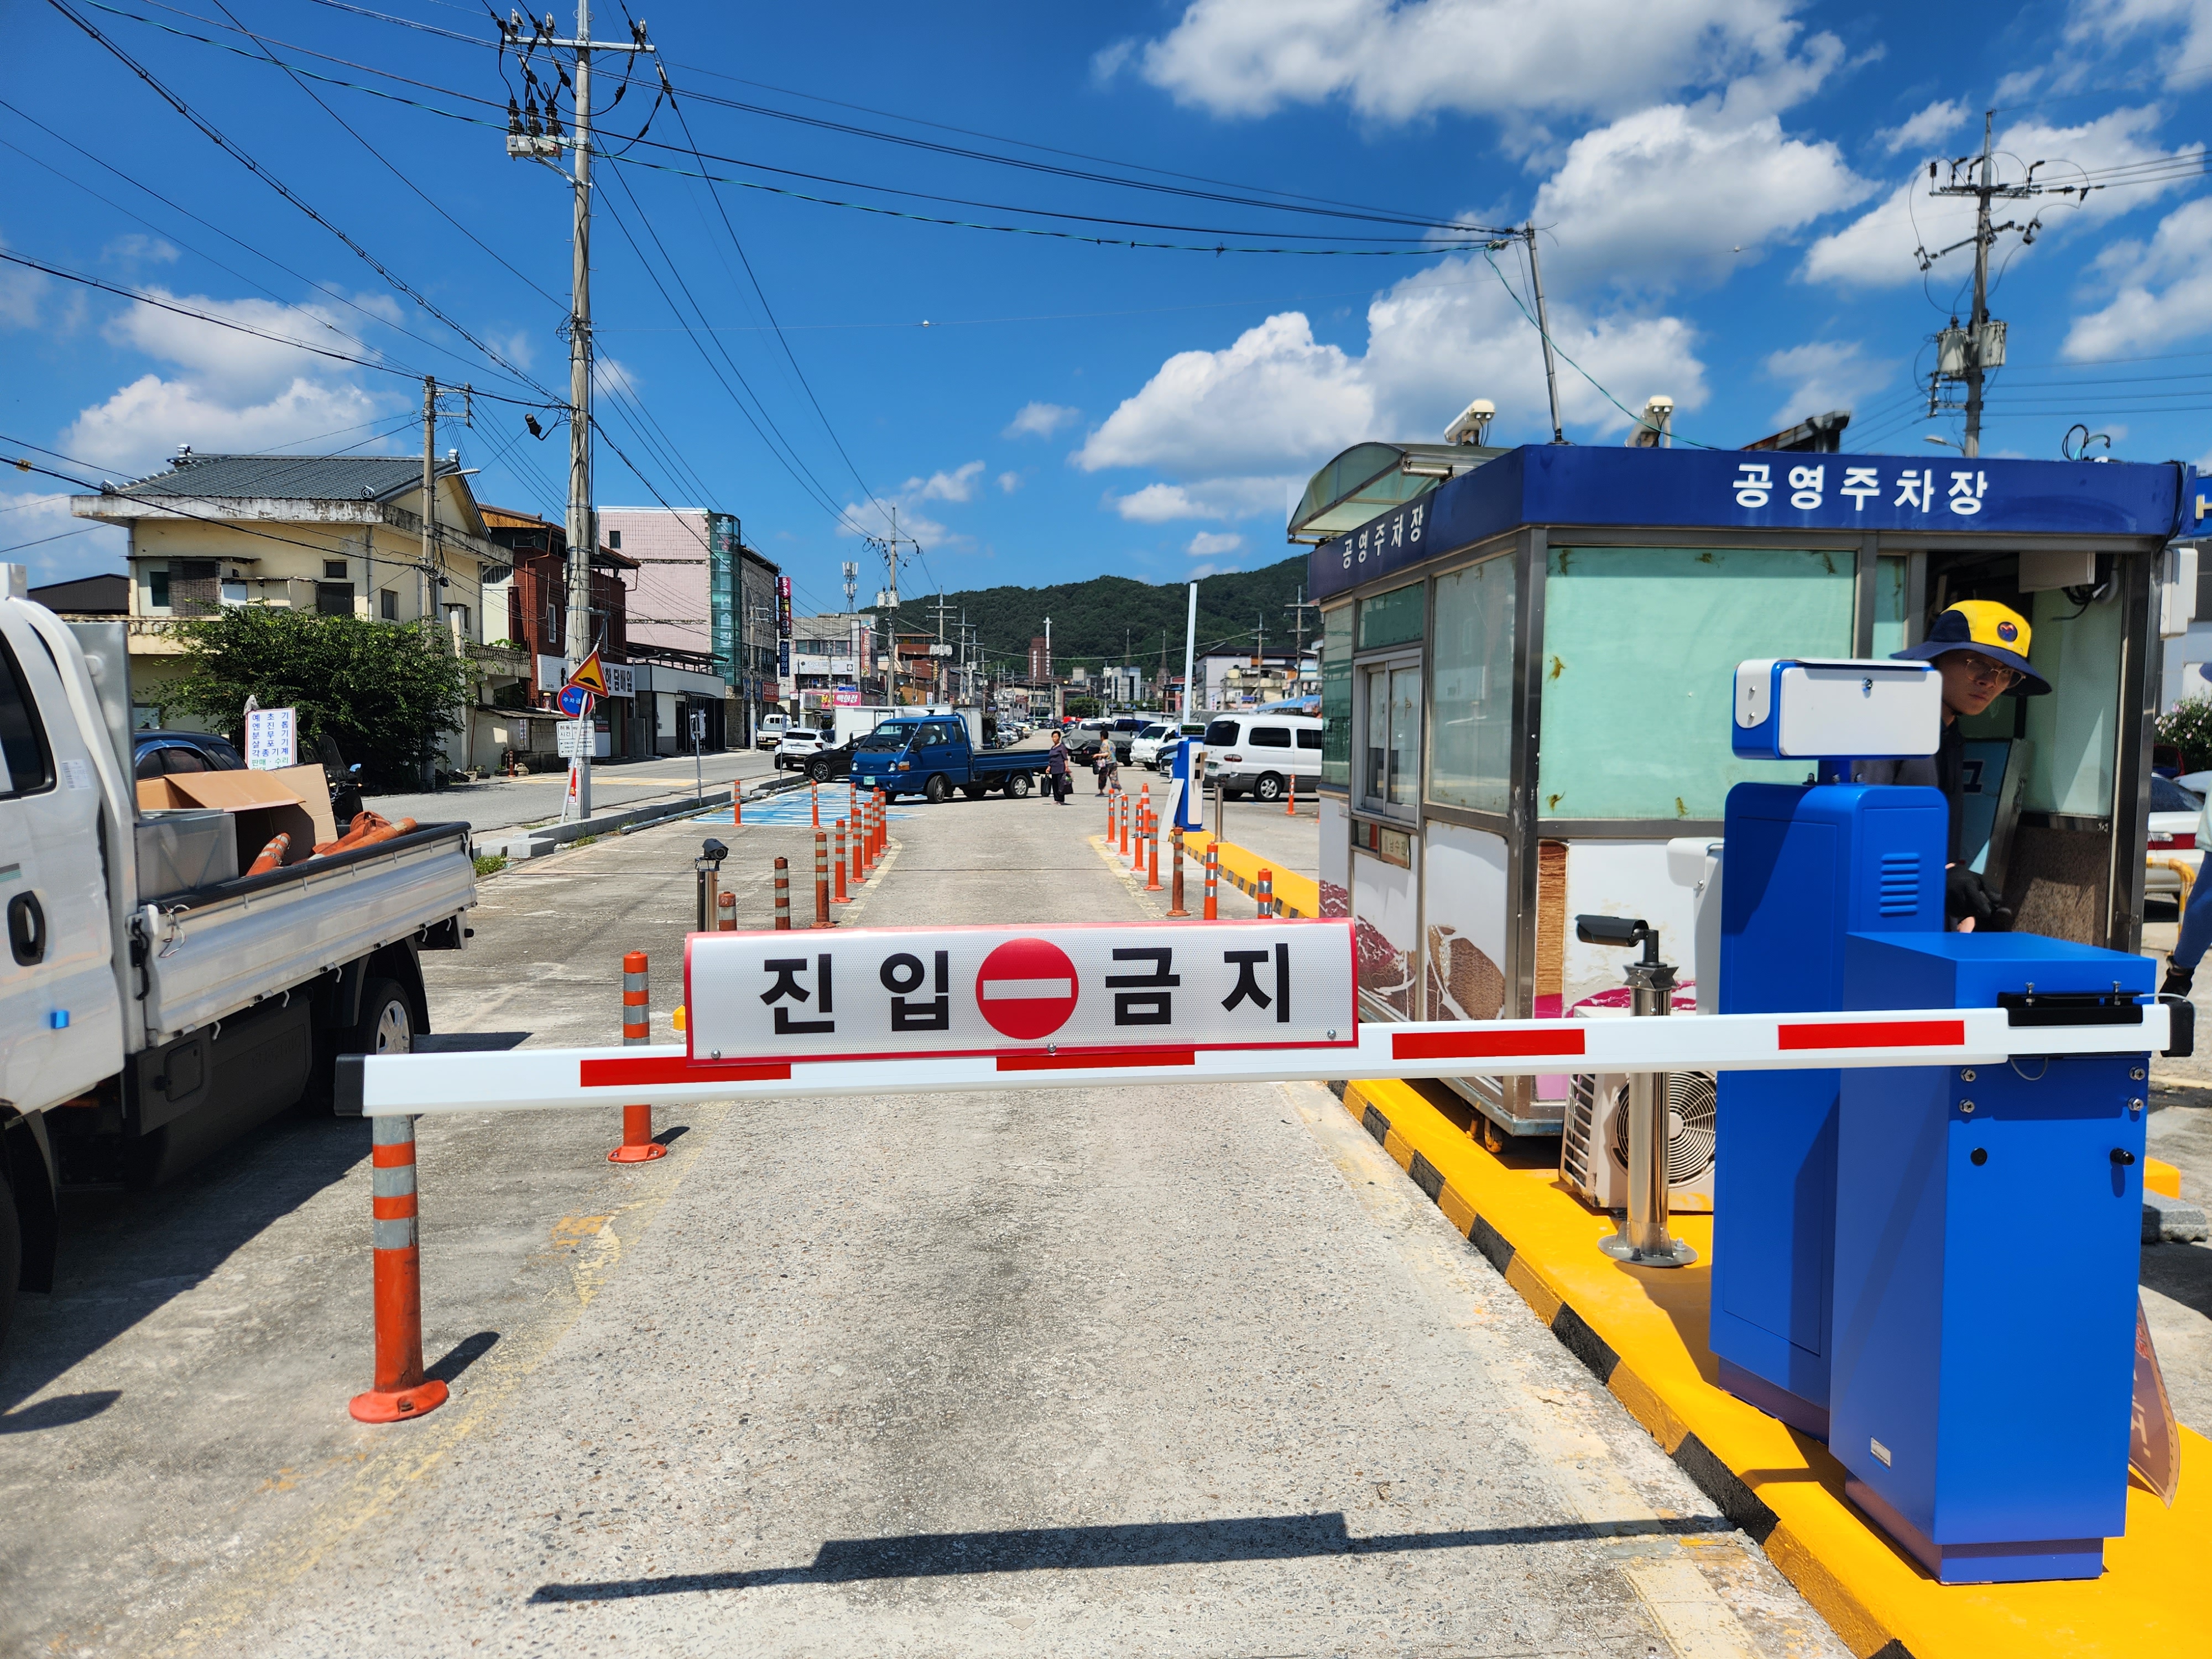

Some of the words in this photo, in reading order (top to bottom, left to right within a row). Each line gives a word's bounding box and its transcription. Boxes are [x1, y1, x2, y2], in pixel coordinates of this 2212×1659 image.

[1732, 462, 1989, 515] 공영주차장
[1343, 503, 1425, 569] 공영주차장
[759, 950, 951, 1035] 진입
[1105, 943, 1291, 1025] 금지
